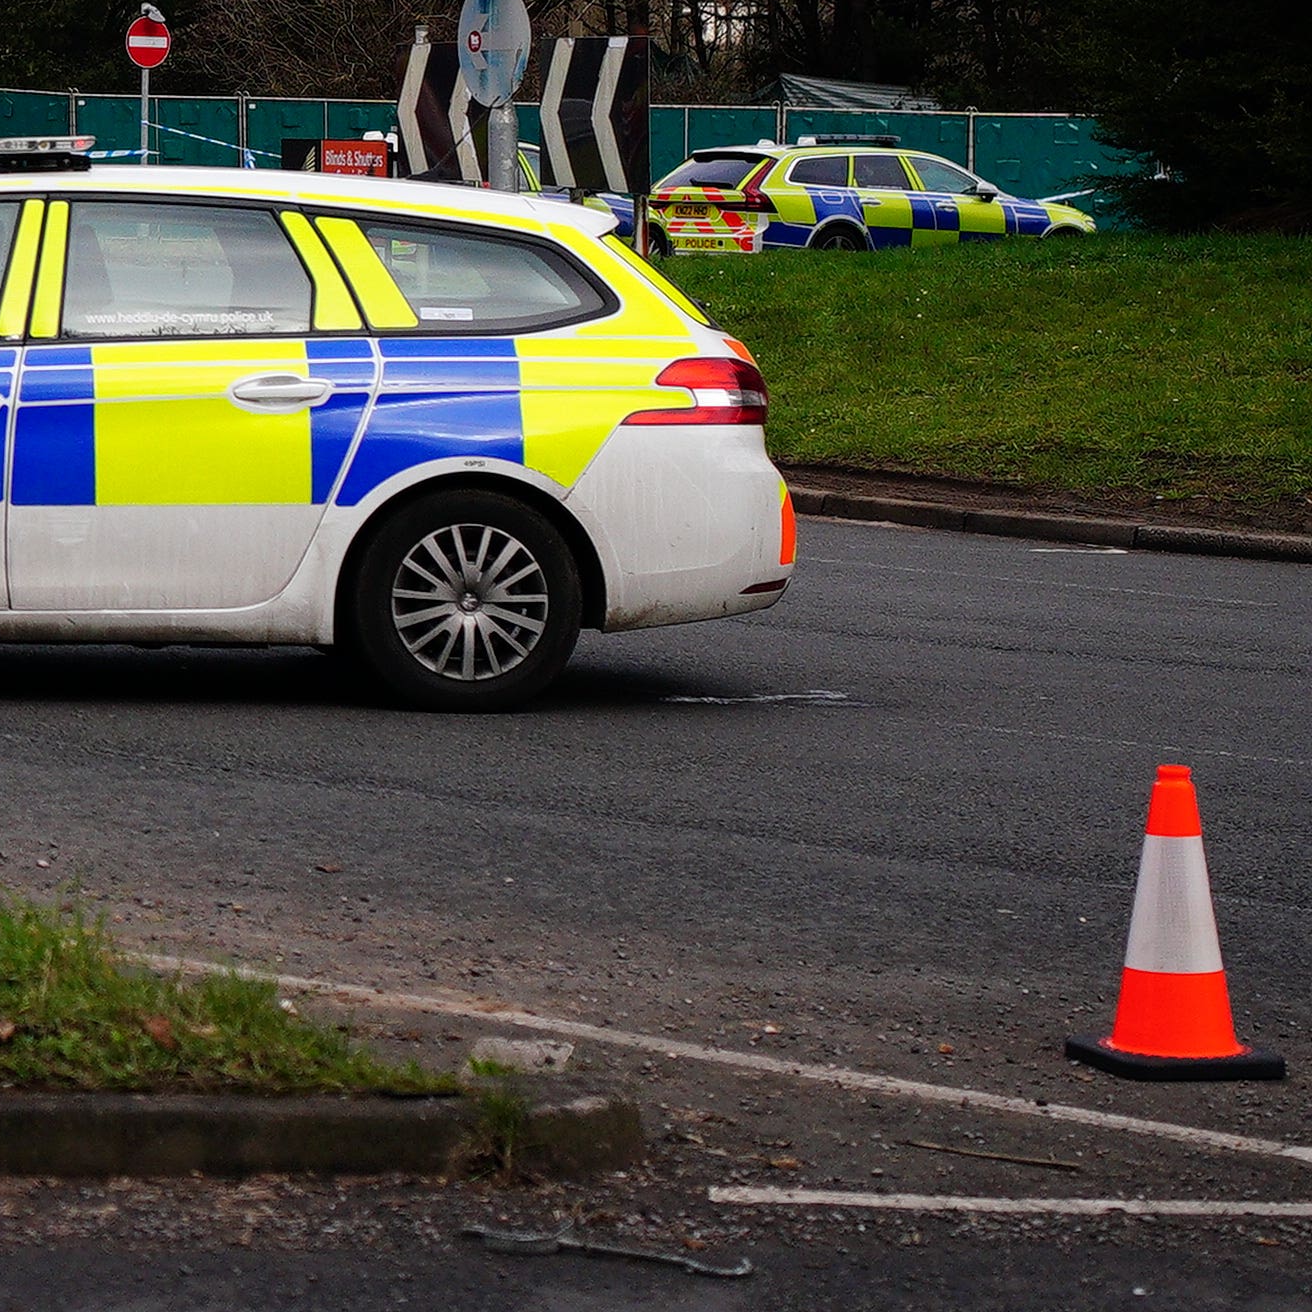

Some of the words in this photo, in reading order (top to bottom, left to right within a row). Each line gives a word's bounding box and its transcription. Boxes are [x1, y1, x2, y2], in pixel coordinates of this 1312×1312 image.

[325, 150, 346, 166] Blinds
[347, 150, 353, 166] &
[686, 238, 716, 249] POLICE
